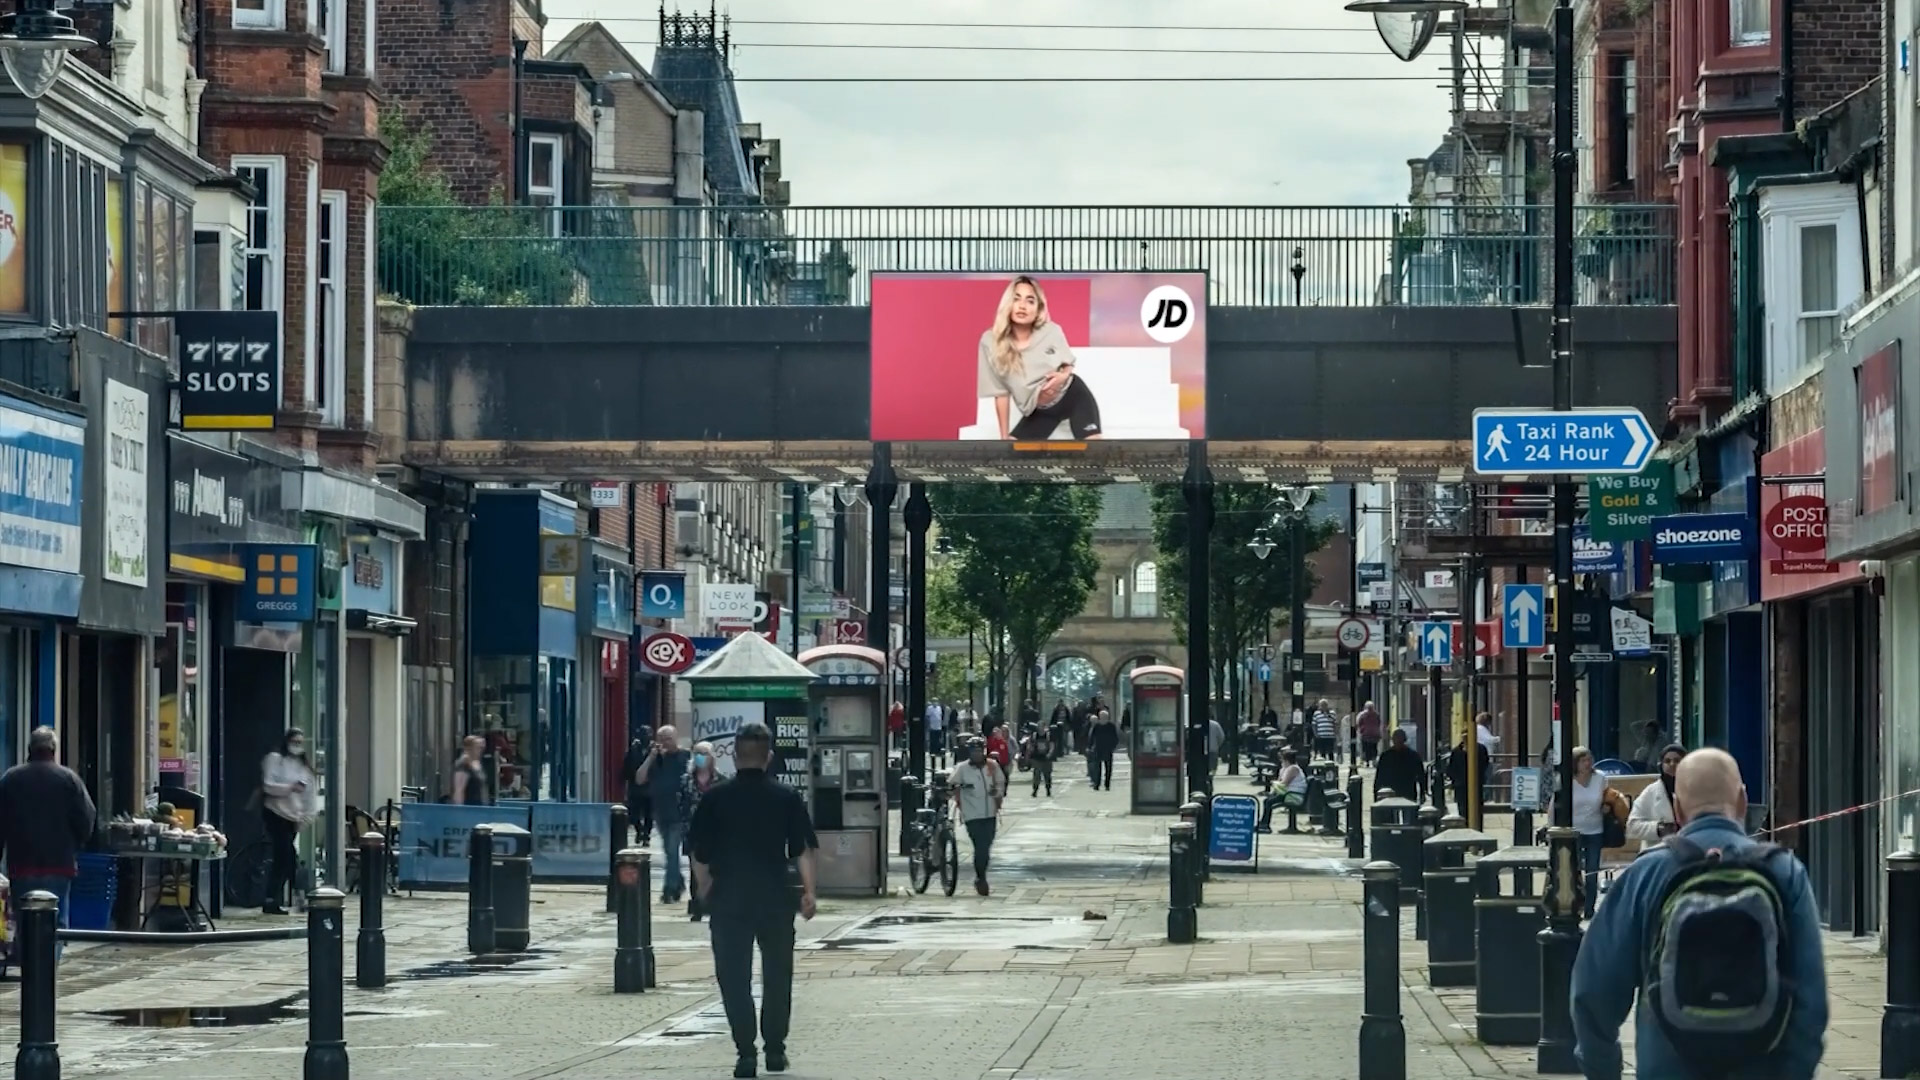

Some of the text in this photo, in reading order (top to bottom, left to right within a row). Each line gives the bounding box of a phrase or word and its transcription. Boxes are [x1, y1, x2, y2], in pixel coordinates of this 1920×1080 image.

[1148, 299, 1188, 328] JD
[187, 372, 270, 392] SLOTS
[1517, 422, 1615, 440] Taxi Rank
[1524, 444, 1609, 461] 24 Hour
[25, 449, 73, 507] BARGAINS
[1596, 476, 1660, 489] We Buy
[1601, 493, 1658, 507] Gold &
[1607, 513, 1655, 526] Silver
[1783, 507, 1825, 522] POST
[1656, 529, 1741, 544] shoezone
[1783, 563, 1828, 572] Travel Money
[712, 591, 746, 600] NEW
[256, 601, 298, 611] GREGGS
[709, 601, 749, 610] LOOK
[443, 827, 470, 836] CAF
[537, 834, 600, 850] ERO
